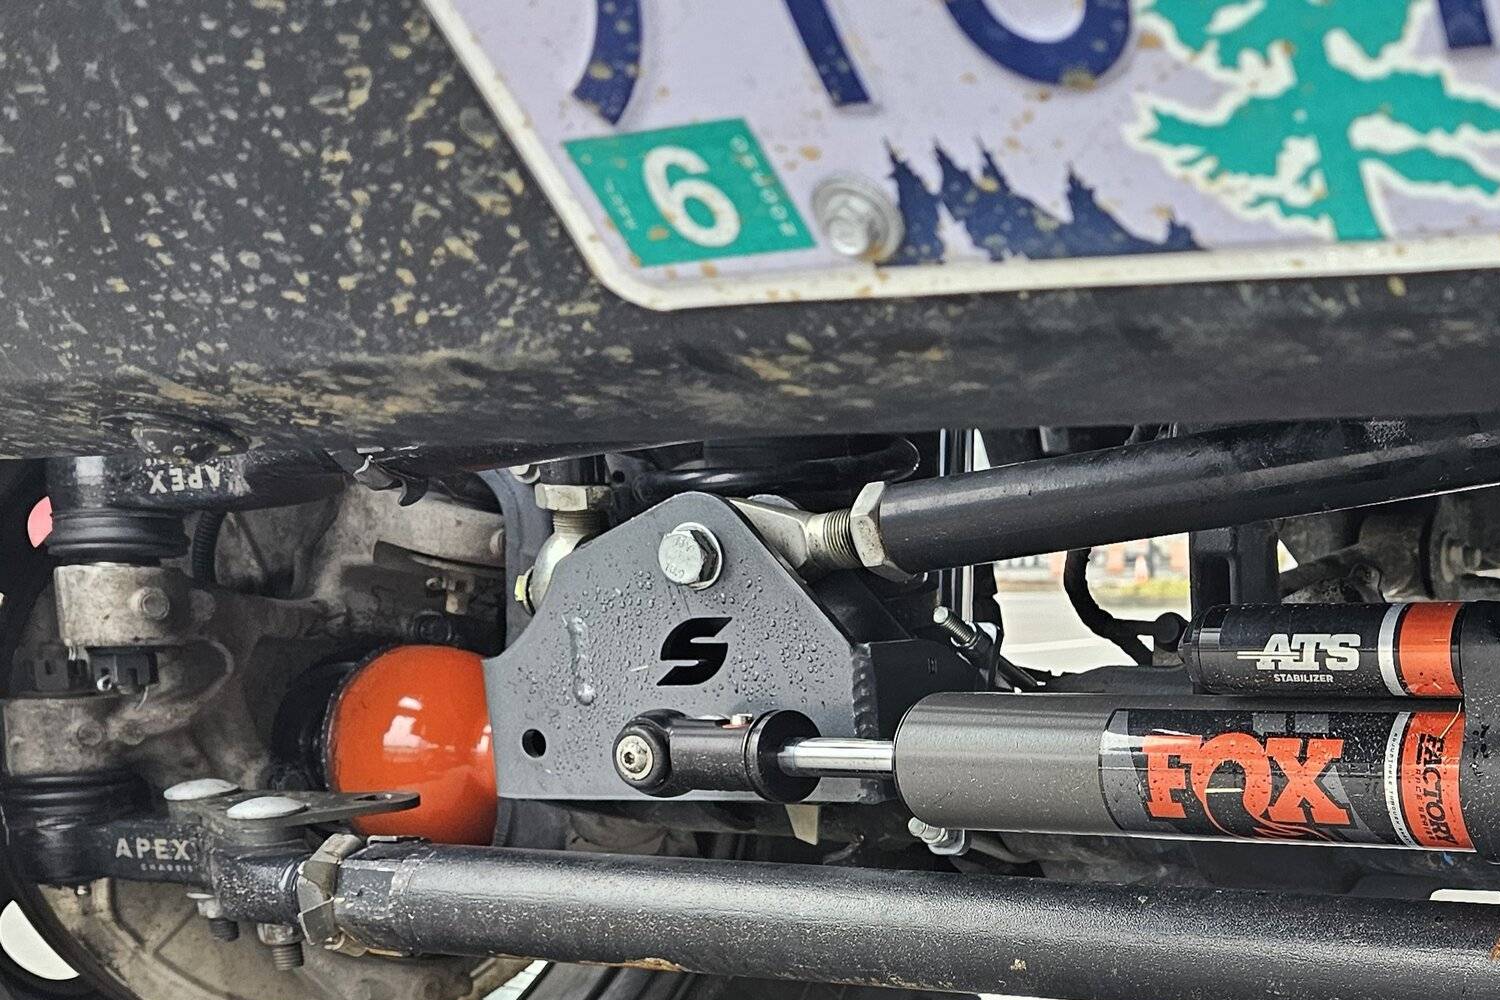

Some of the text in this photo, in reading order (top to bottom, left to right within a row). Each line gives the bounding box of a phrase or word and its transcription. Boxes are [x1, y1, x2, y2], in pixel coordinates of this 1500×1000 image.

[641, 144, 742, 249] 6
[146, 464, 221, 495] APEX
[1237, 633, 1361, 671] ATS
[1273, 673, 1335, 684] STABILIZER
[1142, 732, 1351, 836] FOX
[1422, 733, 1460, 846] FACTORY
[115, 837, 192, 862] APEX
